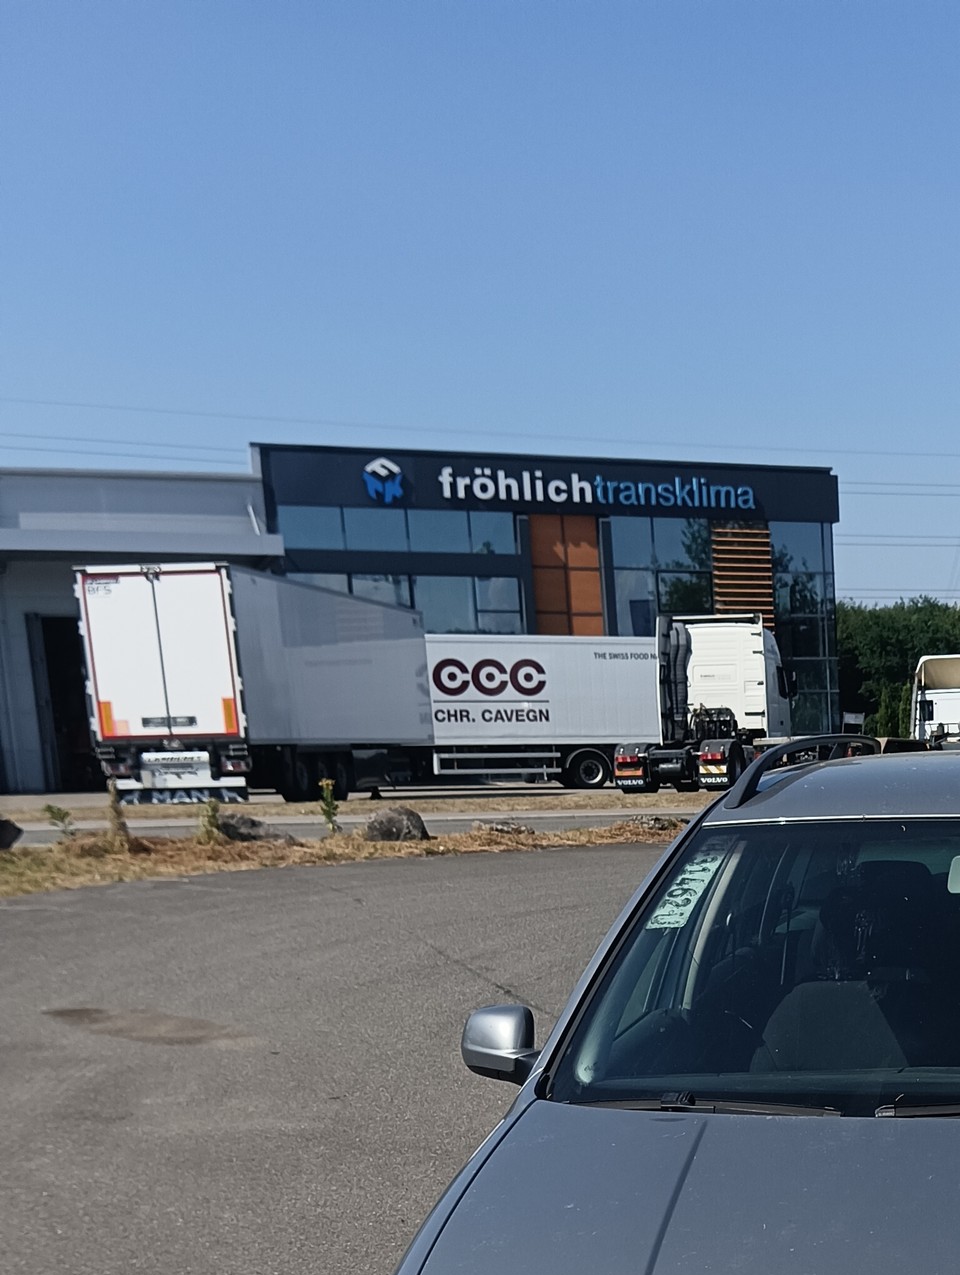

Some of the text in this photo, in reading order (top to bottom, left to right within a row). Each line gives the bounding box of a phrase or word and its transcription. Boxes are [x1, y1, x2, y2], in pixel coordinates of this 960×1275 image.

[593, 652, 607, 660] THE
[608, 652, 629, 660] SWISS
[630, 652, 650, 660] FOOD
[434, 708, 550, 723] CHR. CAVEGN
[616, 778, 644, 786] VOLVO
[700, 776, 728, 784] VOLVO
[151, 789, 210, 804] MAN
